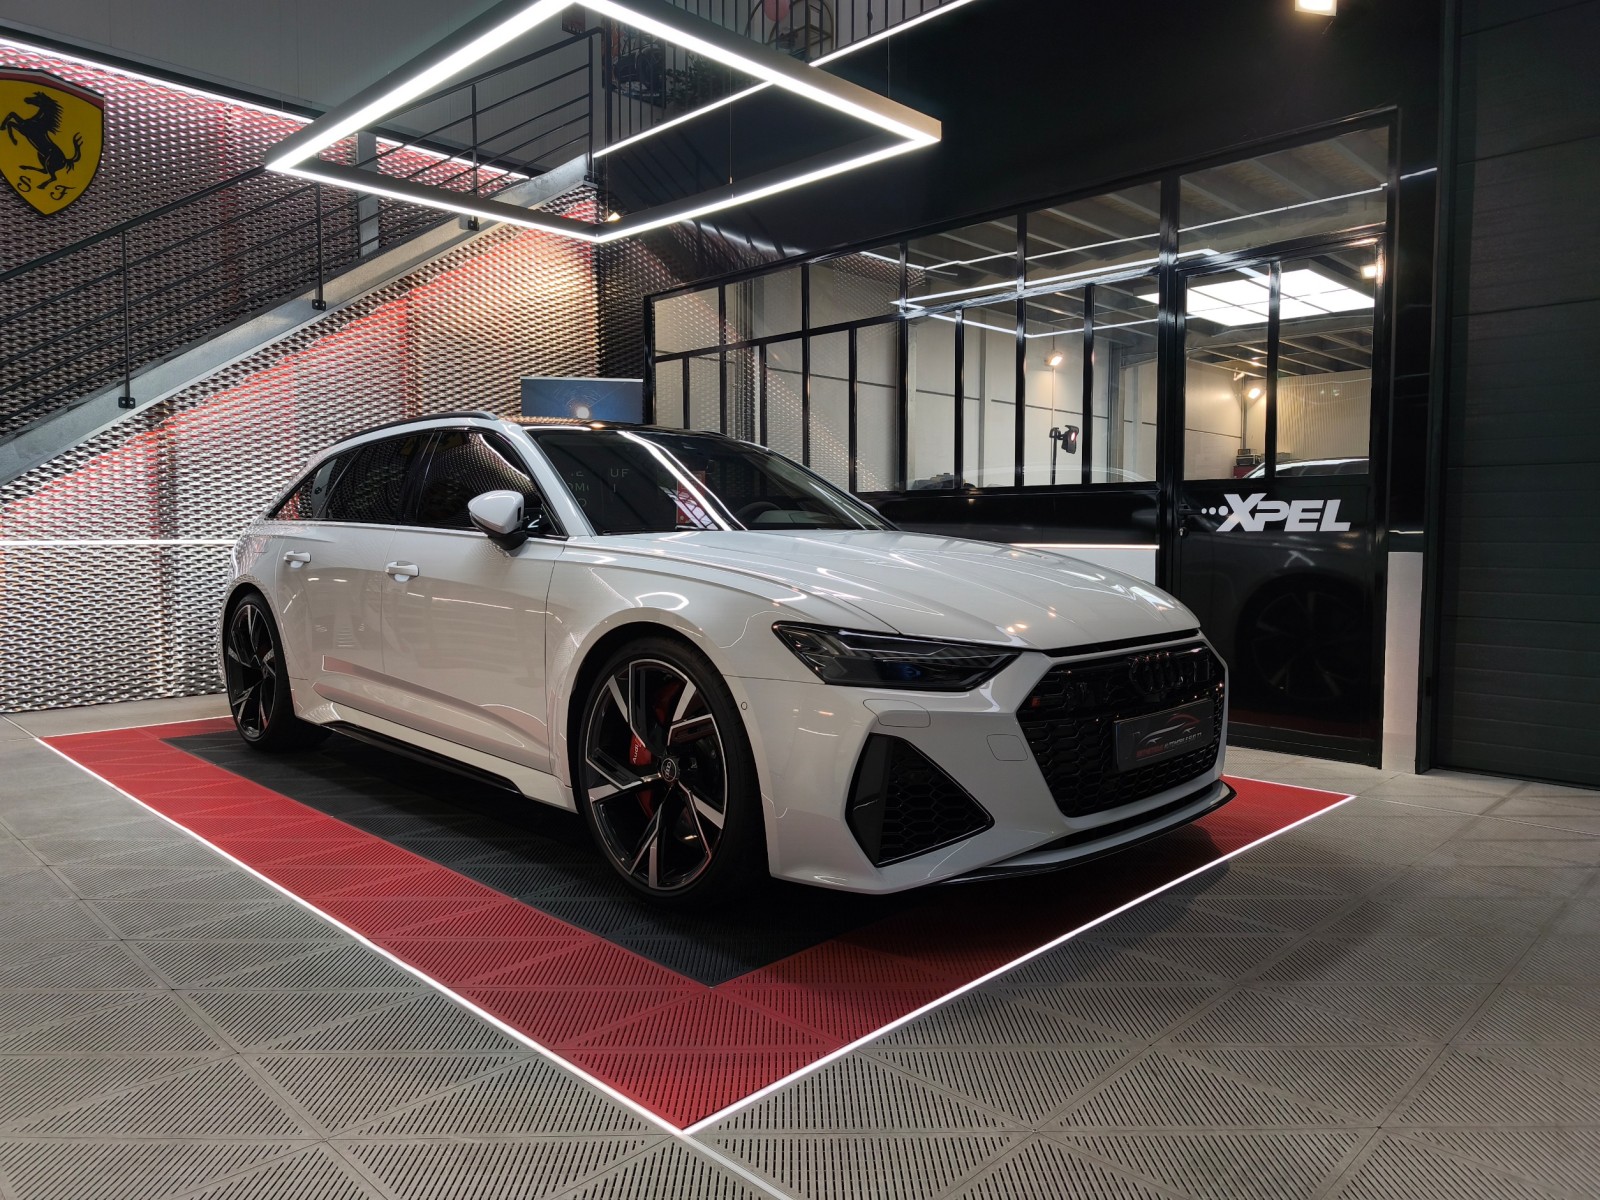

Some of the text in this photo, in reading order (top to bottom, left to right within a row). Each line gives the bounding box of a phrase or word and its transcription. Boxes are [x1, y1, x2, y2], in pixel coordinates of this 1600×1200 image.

[17, 175, 76, 201] S F
[1215, 492, 1352, 533] XPEL
[632, 743, 640, 764] Audi
